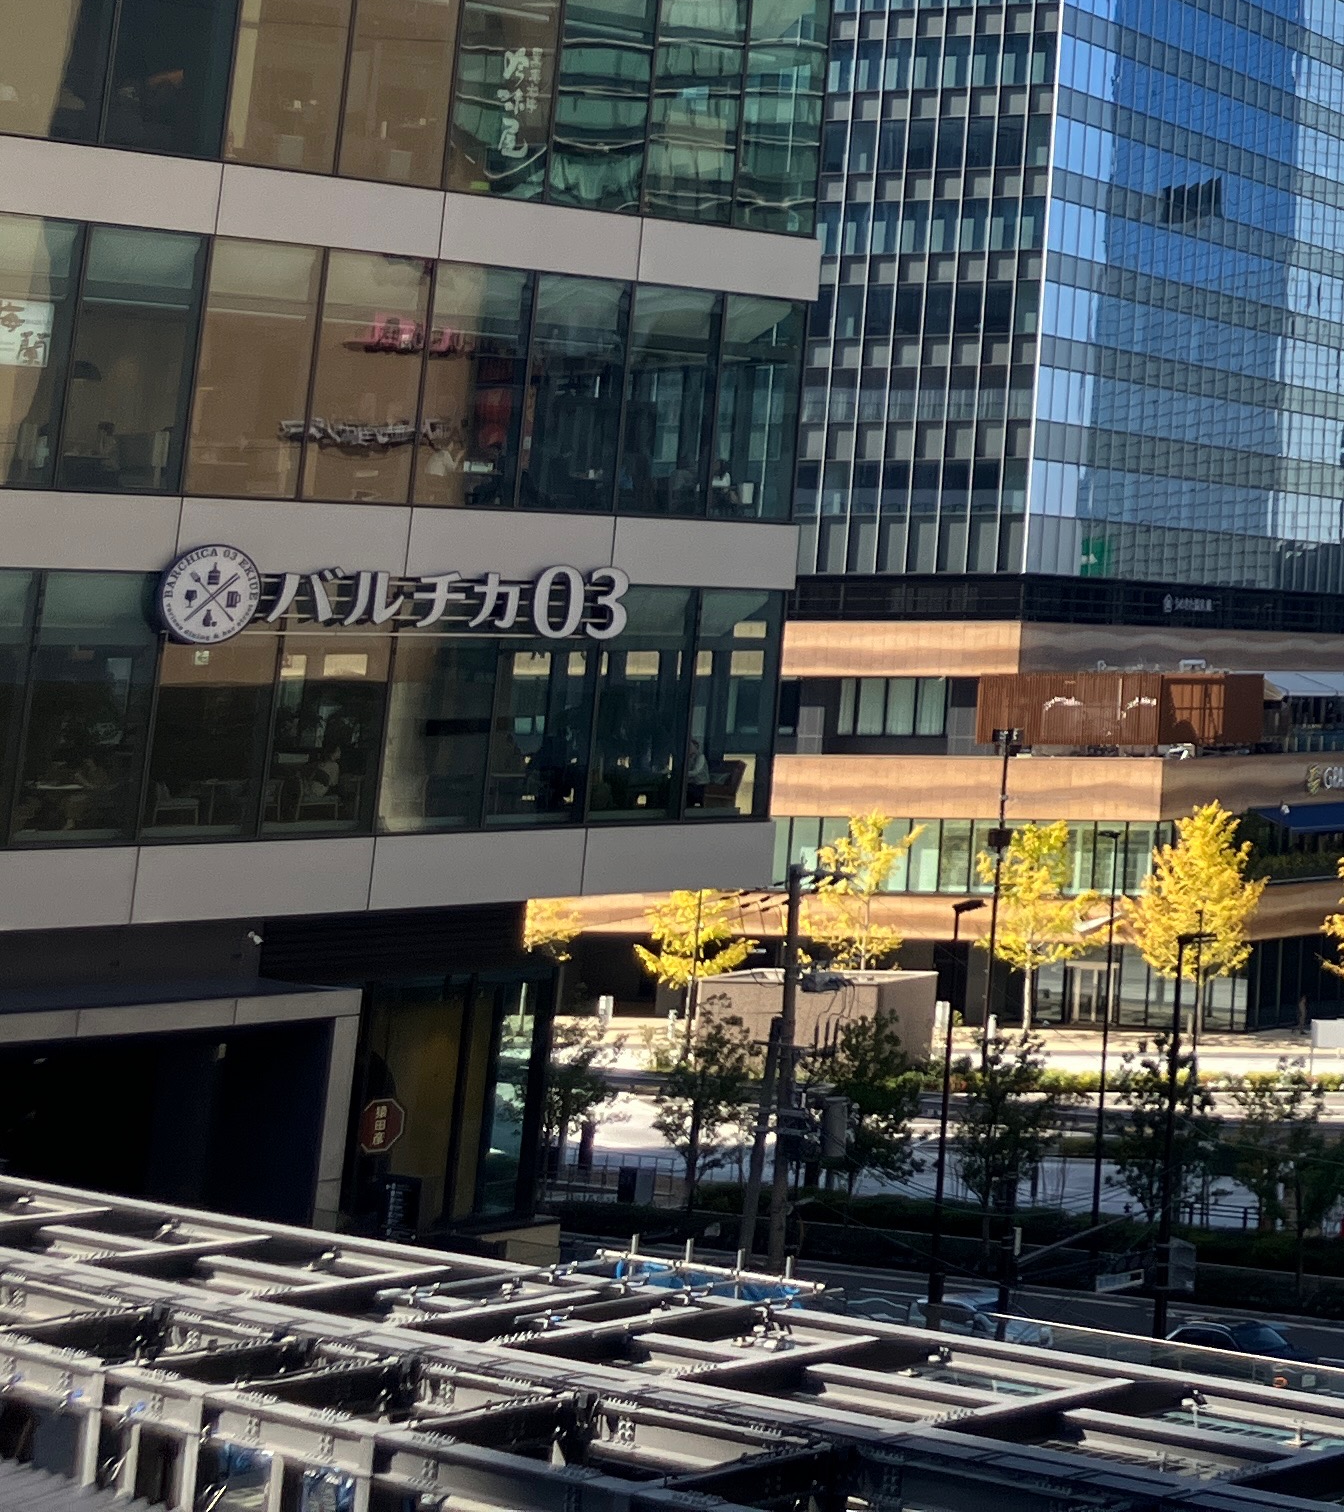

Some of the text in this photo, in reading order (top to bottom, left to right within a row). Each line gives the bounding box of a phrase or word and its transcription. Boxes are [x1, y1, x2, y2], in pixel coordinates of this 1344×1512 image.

[164, 548, 259, 601] BARCHICA 03 EKIUE
[184, 630, 210, 641] dining
